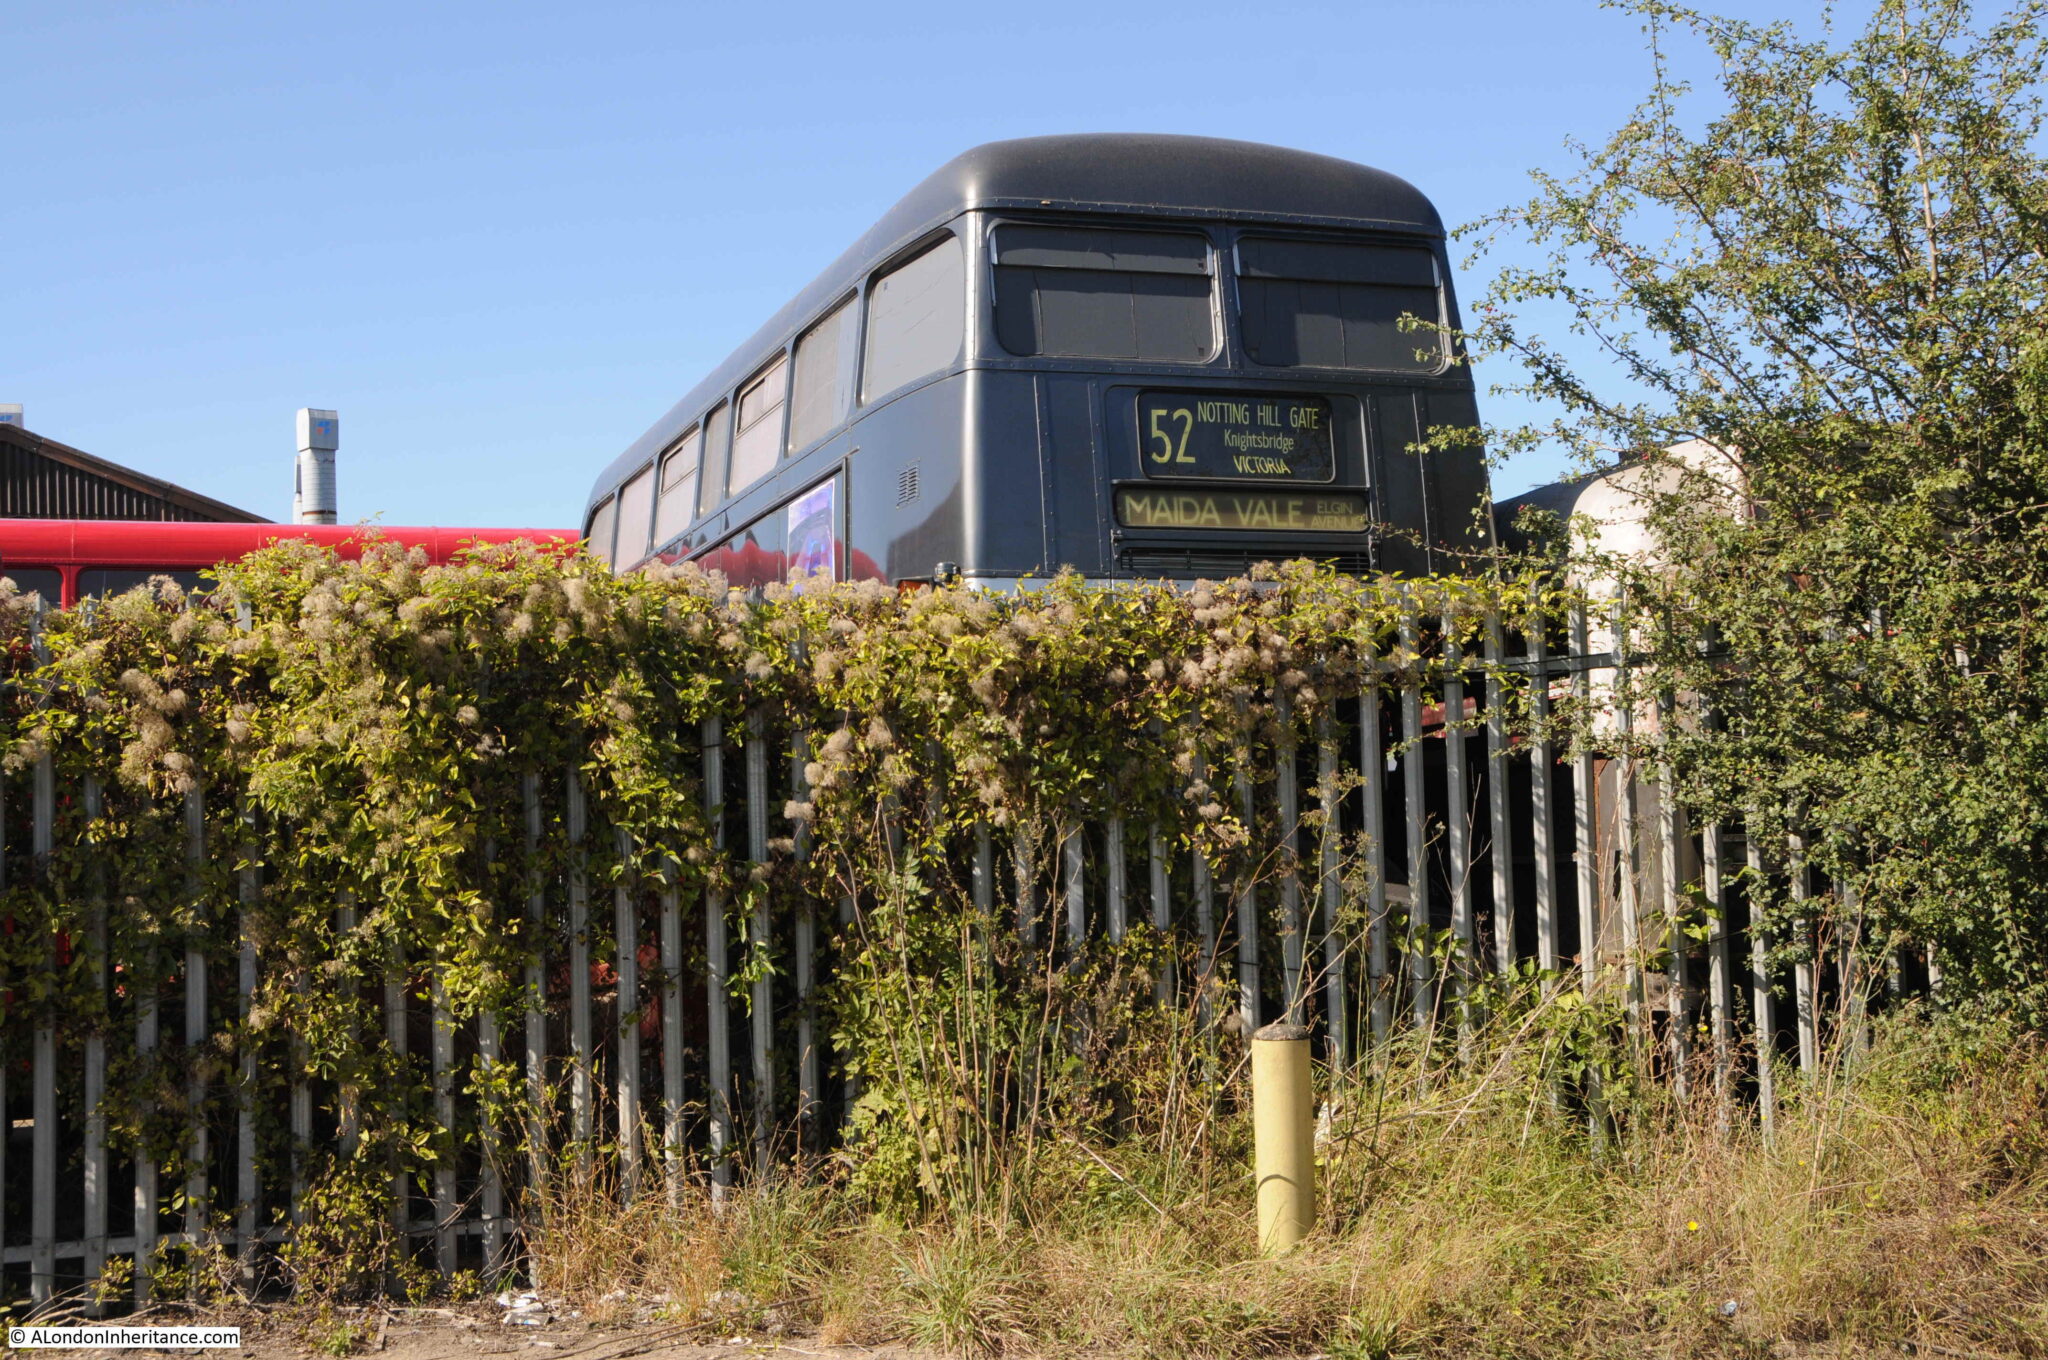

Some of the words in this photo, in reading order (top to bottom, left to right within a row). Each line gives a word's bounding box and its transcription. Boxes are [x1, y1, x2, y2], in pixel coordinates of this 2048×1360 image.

[1198, 401, 1250, 424] NOTTING
[1257, 405, 1282, 427] HILL
[1290, 407, 1319, 430] GATE
[1151, 408, 1195, 463] 52
[1224, 429, 1294, 453] Knightsbridge
[1233, 455, 1291, 474] VICTORIA
[1124, 495, 1221, 526] MAIDA
[1233, 498, 1305, 527] VALE
[1316, 502, 1354, 515] ELGIN
